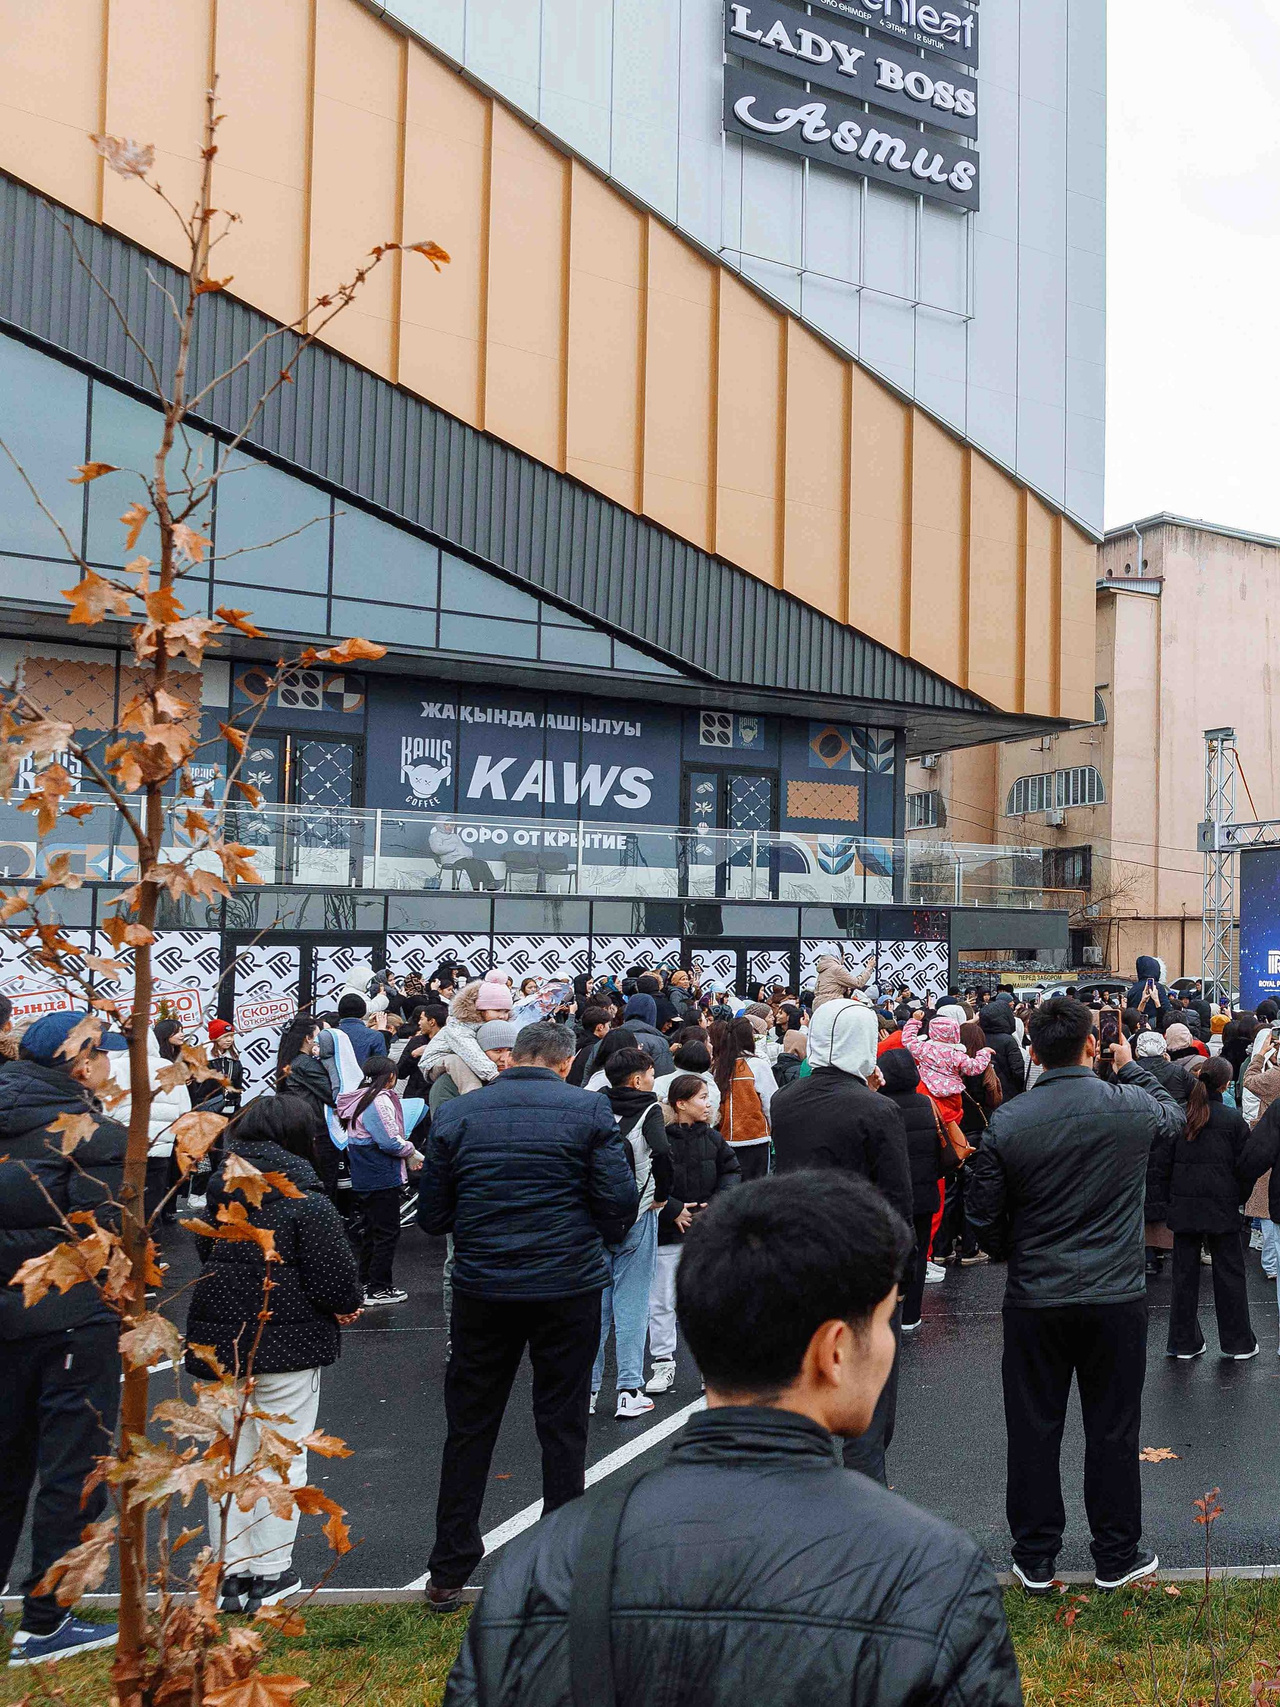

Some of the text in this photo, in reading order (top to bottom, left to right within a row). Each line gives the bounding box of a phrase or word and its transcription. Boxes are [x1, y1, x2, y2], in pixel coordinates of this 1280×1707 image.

[885, 21, 907, 35] ЭТАЖ
[913, 32, 921, 40] 12
[922, 36, 945, 50] БУТИК
[730, 3, 977, 118] LADY BOSS
[734, 95, 977, 192] Asmus
[420, 701, 641, 737] ЖАҚЫНДА АШЫЛУЫ
[466, 754, 654, 809] KAWS
[405, 795, 441, 808] COFFEE
[1258, 979, 1276, 987] ROYAL
[11, 1000, 67, 1016] ында
[242, 1002, 289, 1018] СКОРО
